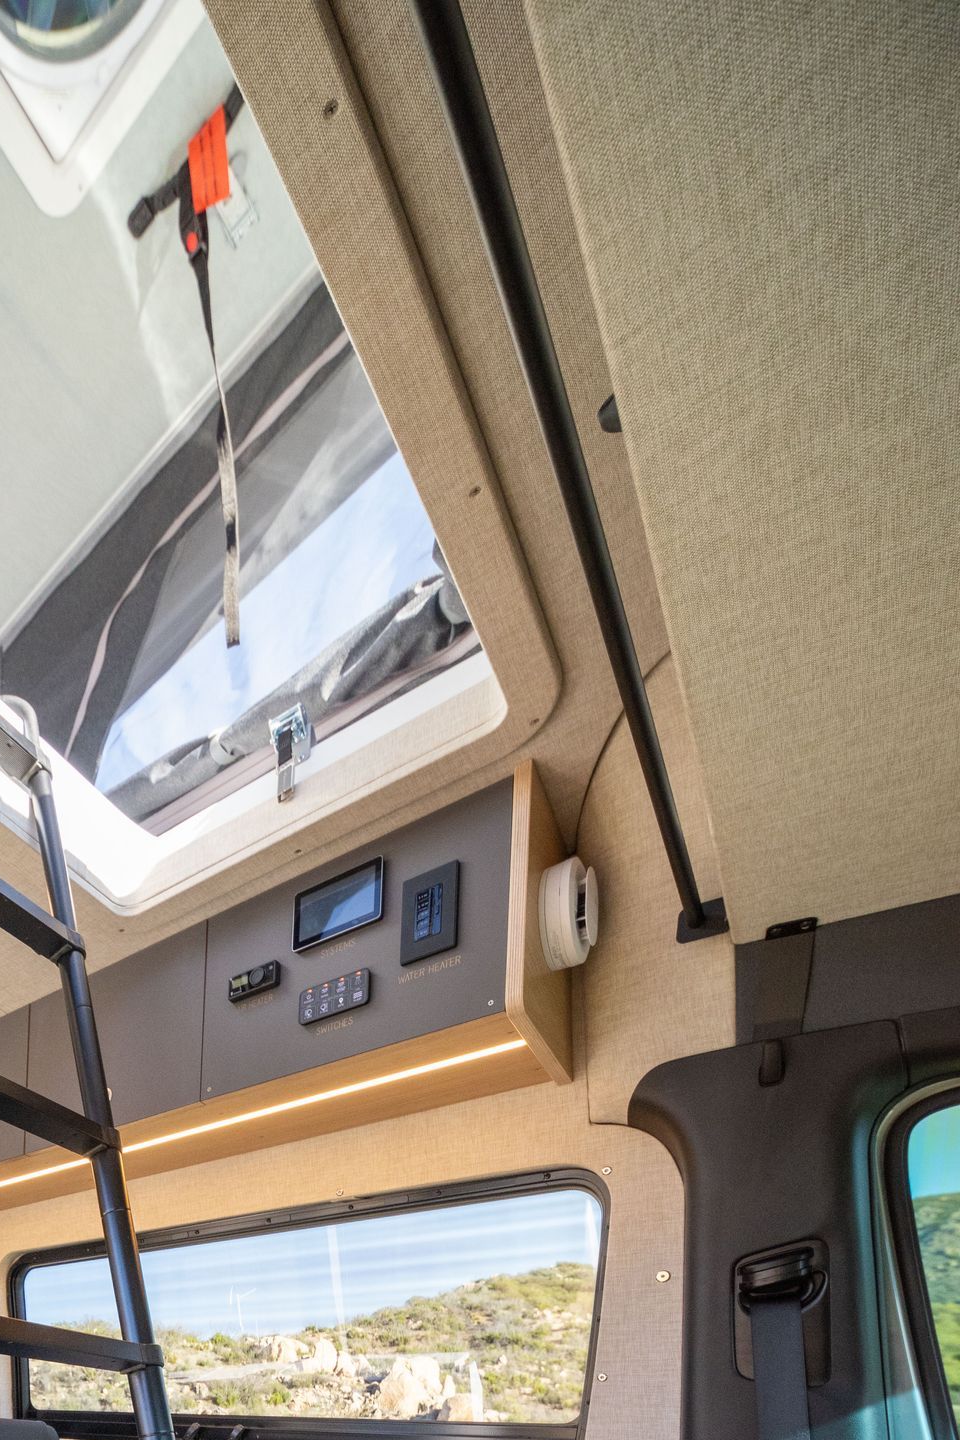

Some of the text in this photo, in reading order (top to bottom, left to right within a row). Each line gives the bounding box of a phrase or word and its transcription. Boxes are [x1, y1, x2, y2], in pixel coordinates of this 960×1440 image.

[320, 939, 356, 959] SYSTEMS
[398, 954, 462, 985] WATER HEATER
[316, 1016, 354, 1036] SWITCHES
